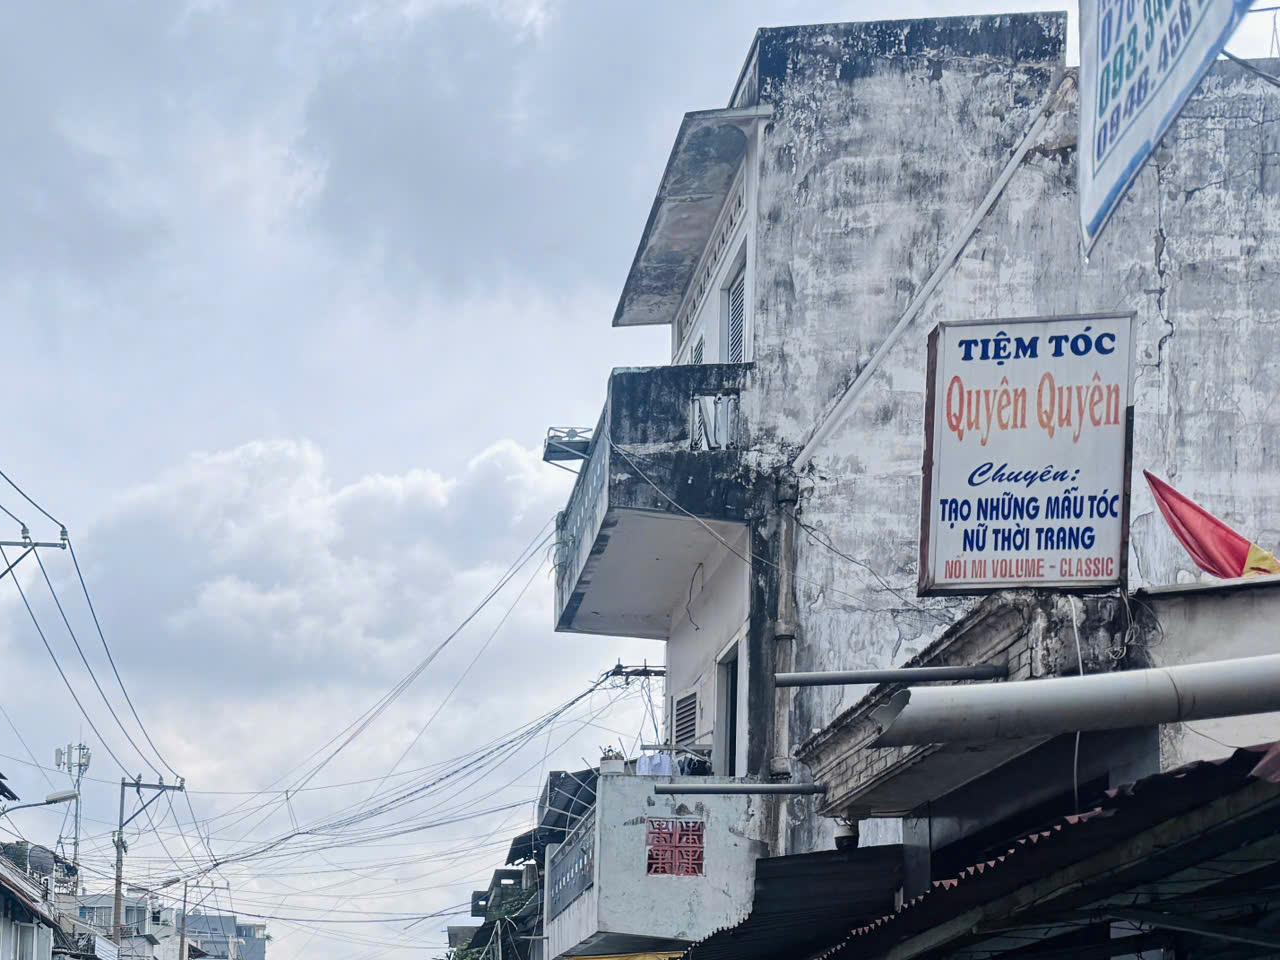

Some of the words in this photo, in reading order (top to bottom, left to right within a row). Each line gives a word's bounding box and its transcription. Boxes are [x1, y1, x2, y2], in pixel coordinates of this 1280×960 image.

[958, 331, 1040, 366] TIỆM
[1048, 326, 1116, 357] TÓC
[945, 375, 1028, 447] Quyên
[1036, 371, 1121, 444] Quyên
[967, 461, 1081, 488] Chuyên:
[940, 497, 972, 529] TẠO
[976, 492, 1040, 521] NHỮNG
[1045, 486, 1085, 519] MẪU
[1087, 489, 1120, 519] TÓC
[962, 523, 988, 552] NỮ
[992, 523, 1030, 551] THỜI
[1035, 526, 1096, 551] TRANG
[971, 558, 987, 579] MI
[992, 557, 1045, 579] VOLUME
[1060, 556, 1114, 578] CLASSIC
